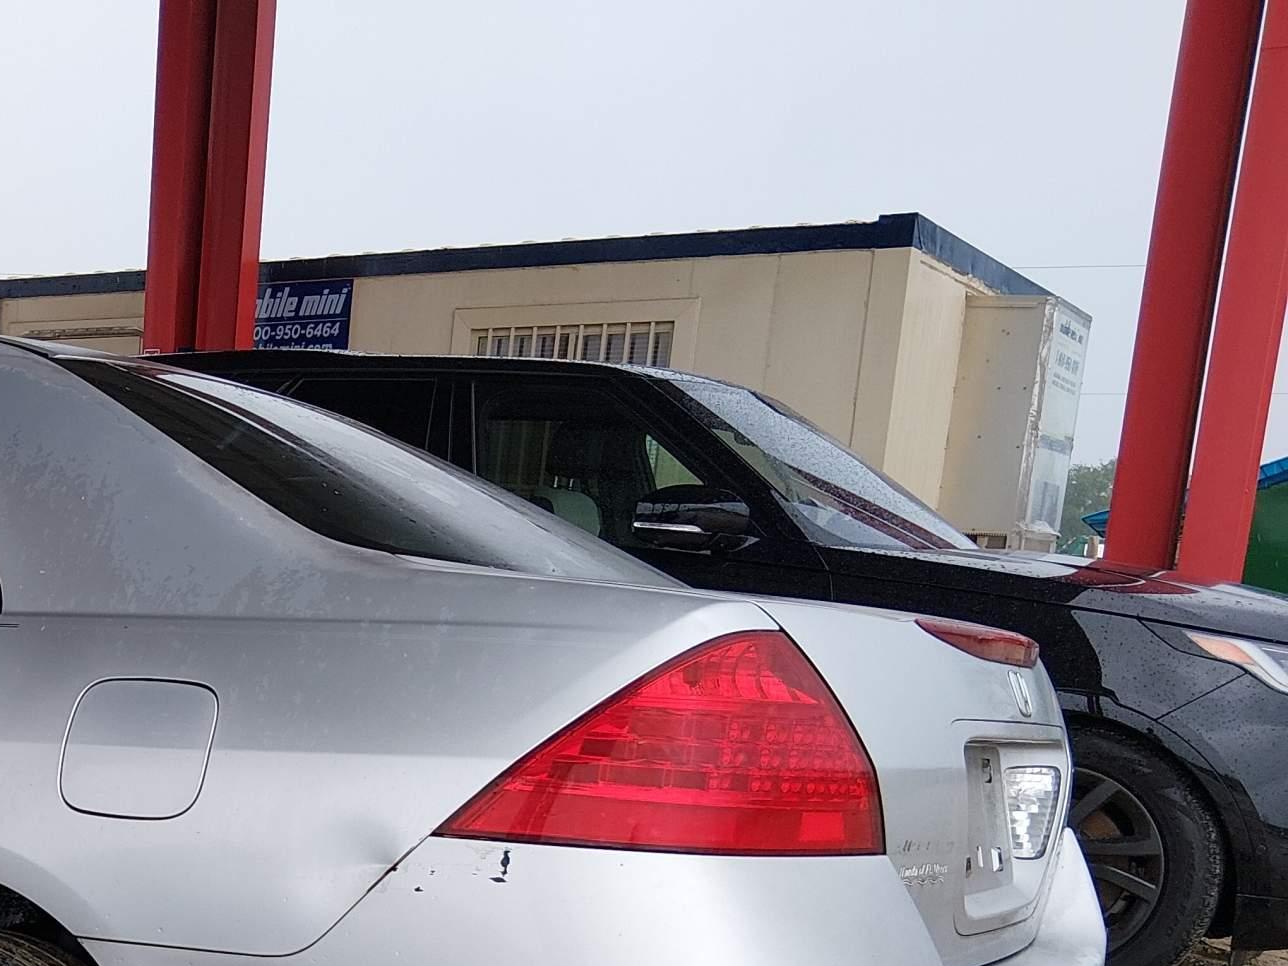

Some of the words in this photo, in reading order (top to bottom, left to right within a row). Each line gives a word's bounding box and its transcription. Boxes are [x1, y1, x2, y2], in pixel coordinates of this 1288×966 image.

[254, 287, 299, 319] bile
[298, 288, 349, 316] mini
[253, 322, 341, 341] 00-950-6464
